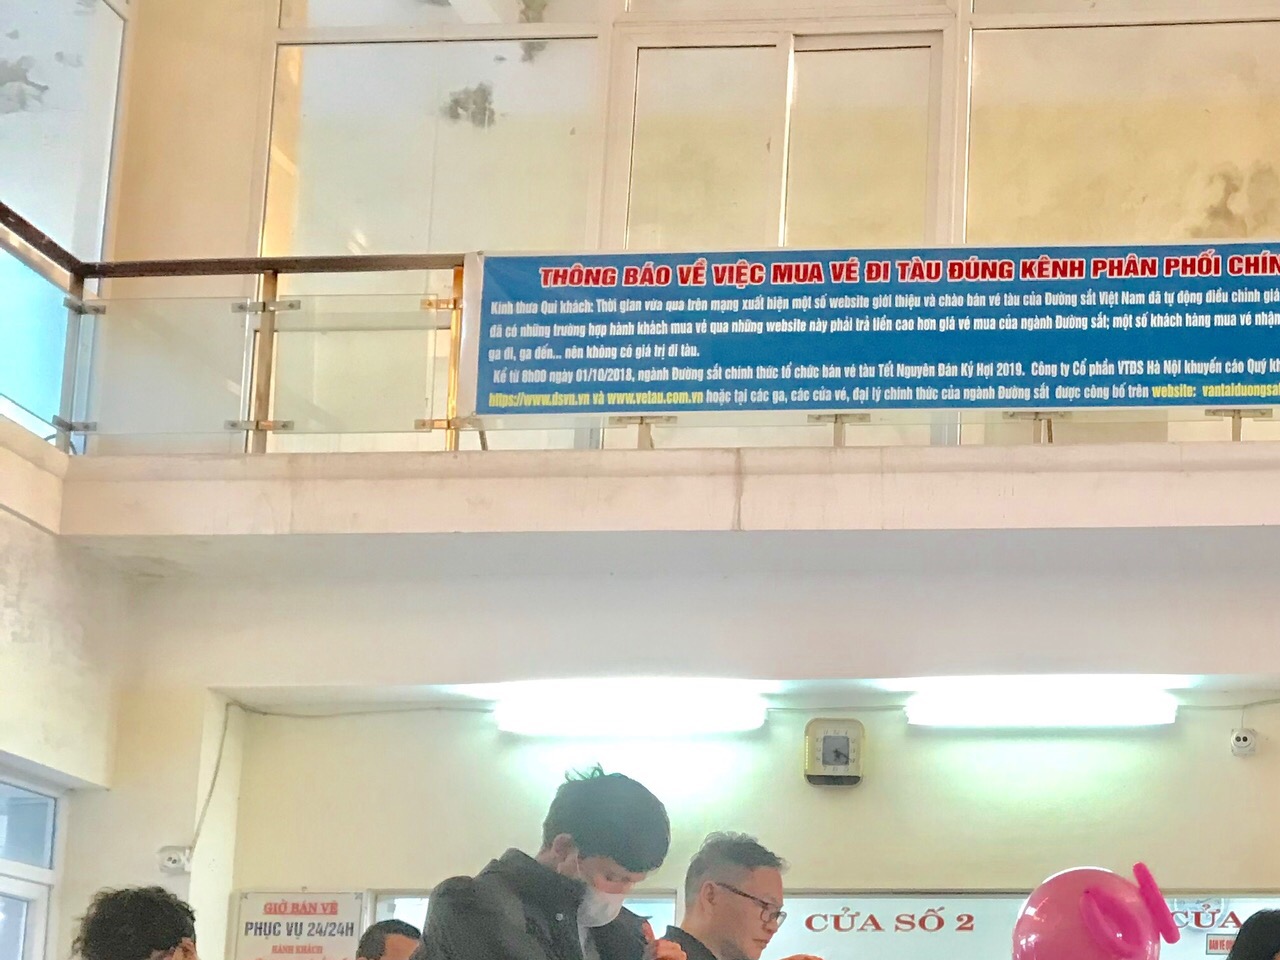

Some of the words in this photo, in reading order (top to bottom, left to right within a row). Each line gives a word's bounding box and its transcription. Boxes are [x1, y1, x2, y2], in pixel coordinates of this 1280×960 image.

[538, 261, 618, 289] THÔNG
[621, 261, 672, 287] BÁO
[676, 257, 707, 286] VỀ
[711, 259, 766, 288] VIỆC
[770, 262, 824, 285] MUA
[828, 256, 860, 284] VÉ
[864, 261, 891, 283] ĐI
[895, 256, 943, 283] TÀU
[946, 255, 1015, 282] ĐÚNG
[1019, 254, 1086, 281] KÊNH
[1090, 252, 1158, 278] PHÂN
[1163, 248, 1221, 277] PHỐI
[559, 299, 593, 313] khách:
[596, 299, 616, 313] Thời
[619, 299, 641, 313] gian
[665, 300, 684, 312] qua
[687, 298, 707, 310] trên
[710, 299, 738, 313] mạng
[742, 295, 764, 310] xuất
[766, 297, 788, 312] hiện
[791, 296, 811, 312] một
[829, 295, 869, 308] website
[872, 295, 891, 309] giới
[894, 294, 920, 310] thiệu
[938, 294, 963, 307] chào
[966, 293, 985, 307] bán
[1023, 291, 1041, 306] của
[1044, 292, 1077, 307] Đường
[1099, 291, 1118, 307] Việt
[1121, 292, 1145, 304] Nam
[1177, 291, 1202, 306] động
[1205, 288, 1228, 302] điều
[1231, 288, 1260, 302] chỉnh
[520, 324, 550, 338] những
[553, 323, 585, 338] trường
[588, 323, 607, 338] hợp
[609, 321, 634, 336] hành
[636, 320, 668, 335] khách
[670, 322, 692, 334] mua
[709, 322, 728, 334] qua
[731, 319, 763, 335] những
[766, 318, 806, 332] website
[809, 318, 827, 333] này
[830, 317, 852, 333] phải
[872, 315, 892, 331] tiền
[895, 319, 914, 331] cao
[917, 317, 936, 330] hơn
[973, 318, 996, 329] mua
[998, 318, 1017, 329] của
[1020, 315, 1052, 331] ngành
[1055, 315, 1087, 330] Đường
[1112, 314, 1132, 330] một
[1150, 313, 1182, 327] khách
[1185, 312, 1210, 328] hàng
[1214, 314, 1236, 326] mua
[1254, 311, 1280, 328] nhận
[564, 345, 583, 359] nên
[586, 345, 617, 360] không
[680, 343, 700, 356] tàu.
[549, 369, 573, 384] ngày
[575, 367, 634, 383] 01/10/2018,
[637, 367, 669, 382] ngành
[671, 366, 703, 382] Đường
[724, 366, 753, 380] chính
[756, 366, 778, 379] thức
[794, 365, 819, 378] chức
[896, 363, 935, 379] Nguyên
[937, 363, 957, 376] Đán
[996, 363, 1024, 376] 2019.
[1031, 361, 1057, 377] Công
[1089, 359, 1114, 376] phần
[1184, 357, 1221, 375] khuyến
[1225, 359, 1244, 373] cáo
[1247, 358, 1266, 374] Quý
[606, 390, 703, 405] www.vetau.com.vn
[705, 389, 731, 406] hoặc
[884, 386, 912, 400] chính
[915, 386, 938, 400] thức
[963, 386, 995, 401] ngành
[997, 385, 1030, 401] Đường
[1055, 386, 1080, 401] được
[1083, 384, 1109, 400] công
[1128, 384, 1148, 398] trên
[1151, 384, 1196, 397] website:
[263, 899, 287, 915] GIỜ
[291, 899, 317, 915] BÁN
[321, 899, 338, 915] VÉ
[805, 907, 885, 932] CỬA
[895, 907, 945, 932] SỐ
[956, 914, 974, 931] 2
[1171, 904, 1243, 929] CỬA
[244, 922, 281, 940] PHỤC
[286, 922, 303, 940] VỤ
[307, 922, 354, 937] 24/24H
